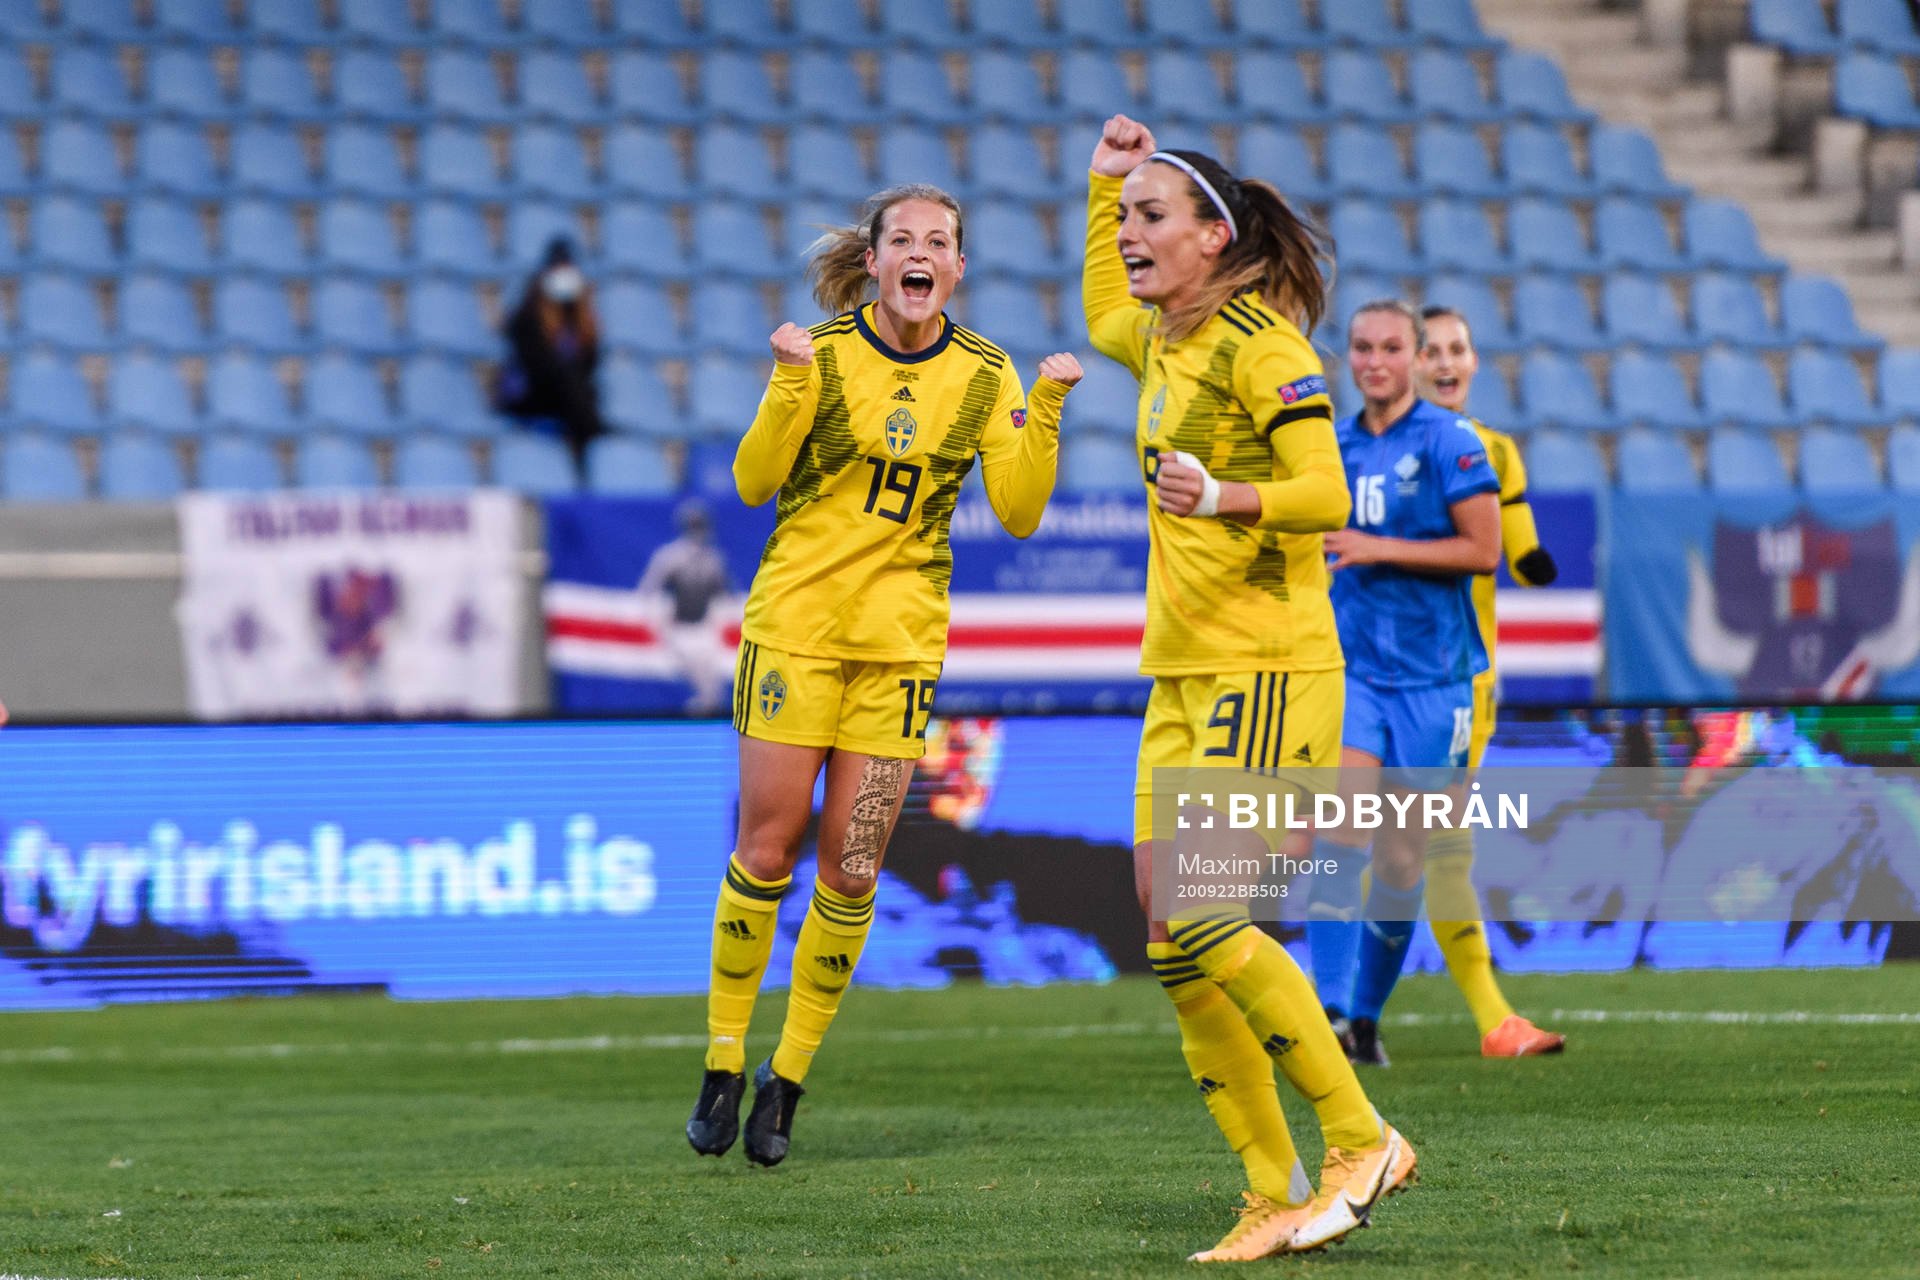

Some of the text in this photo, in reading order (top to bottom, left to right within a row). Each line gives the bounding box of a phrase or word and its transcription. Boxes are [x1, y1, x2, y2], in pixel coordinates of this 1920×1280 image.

[863, 456, 923, 524] 19
[1355, 474, 1386, 527] 15
[899, 678, 936, 739] 19
[1204, 692, 1245, 758] 9
